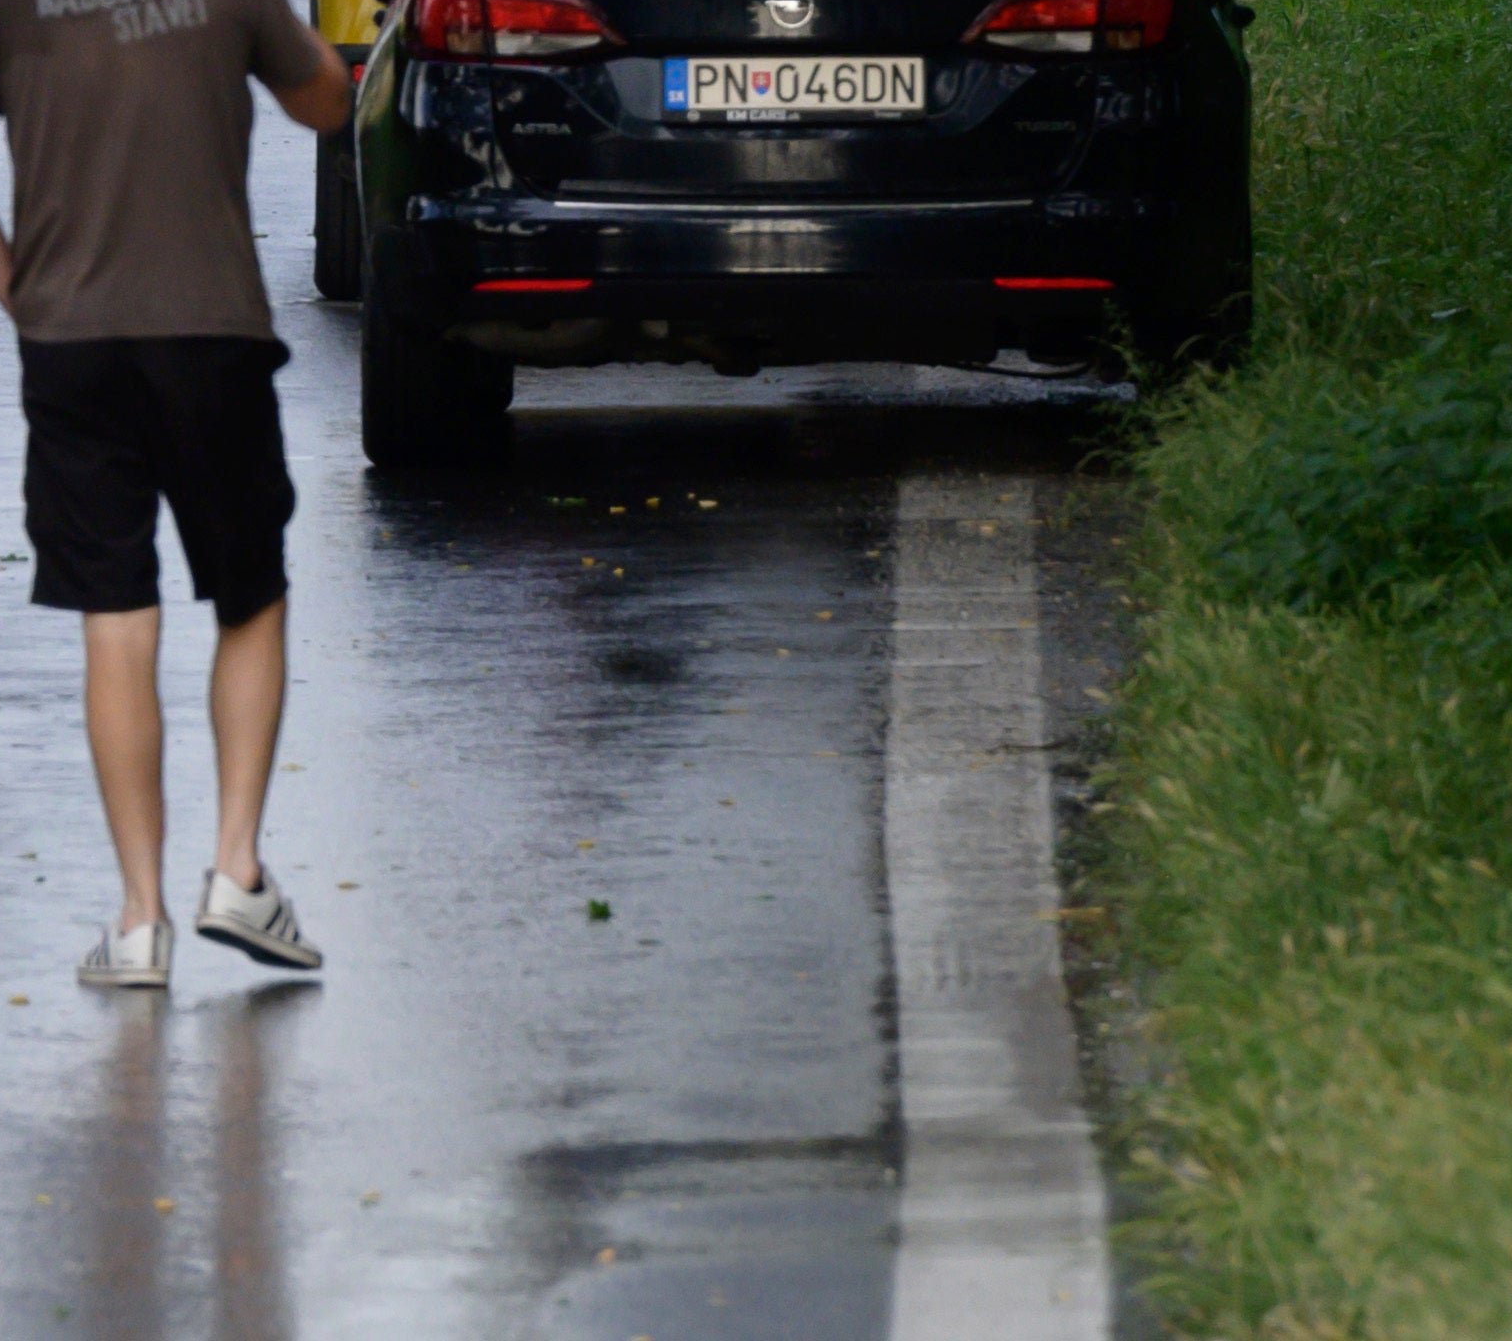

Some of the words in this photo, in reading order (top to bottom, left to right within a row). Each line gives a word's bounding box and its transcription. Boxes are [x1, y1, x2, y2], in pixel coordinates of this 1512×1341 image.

[694, 64, 748, 104] PN
[775, 62, 916, 104] 046DN
[512, 122, 573, 135] ASTRA
